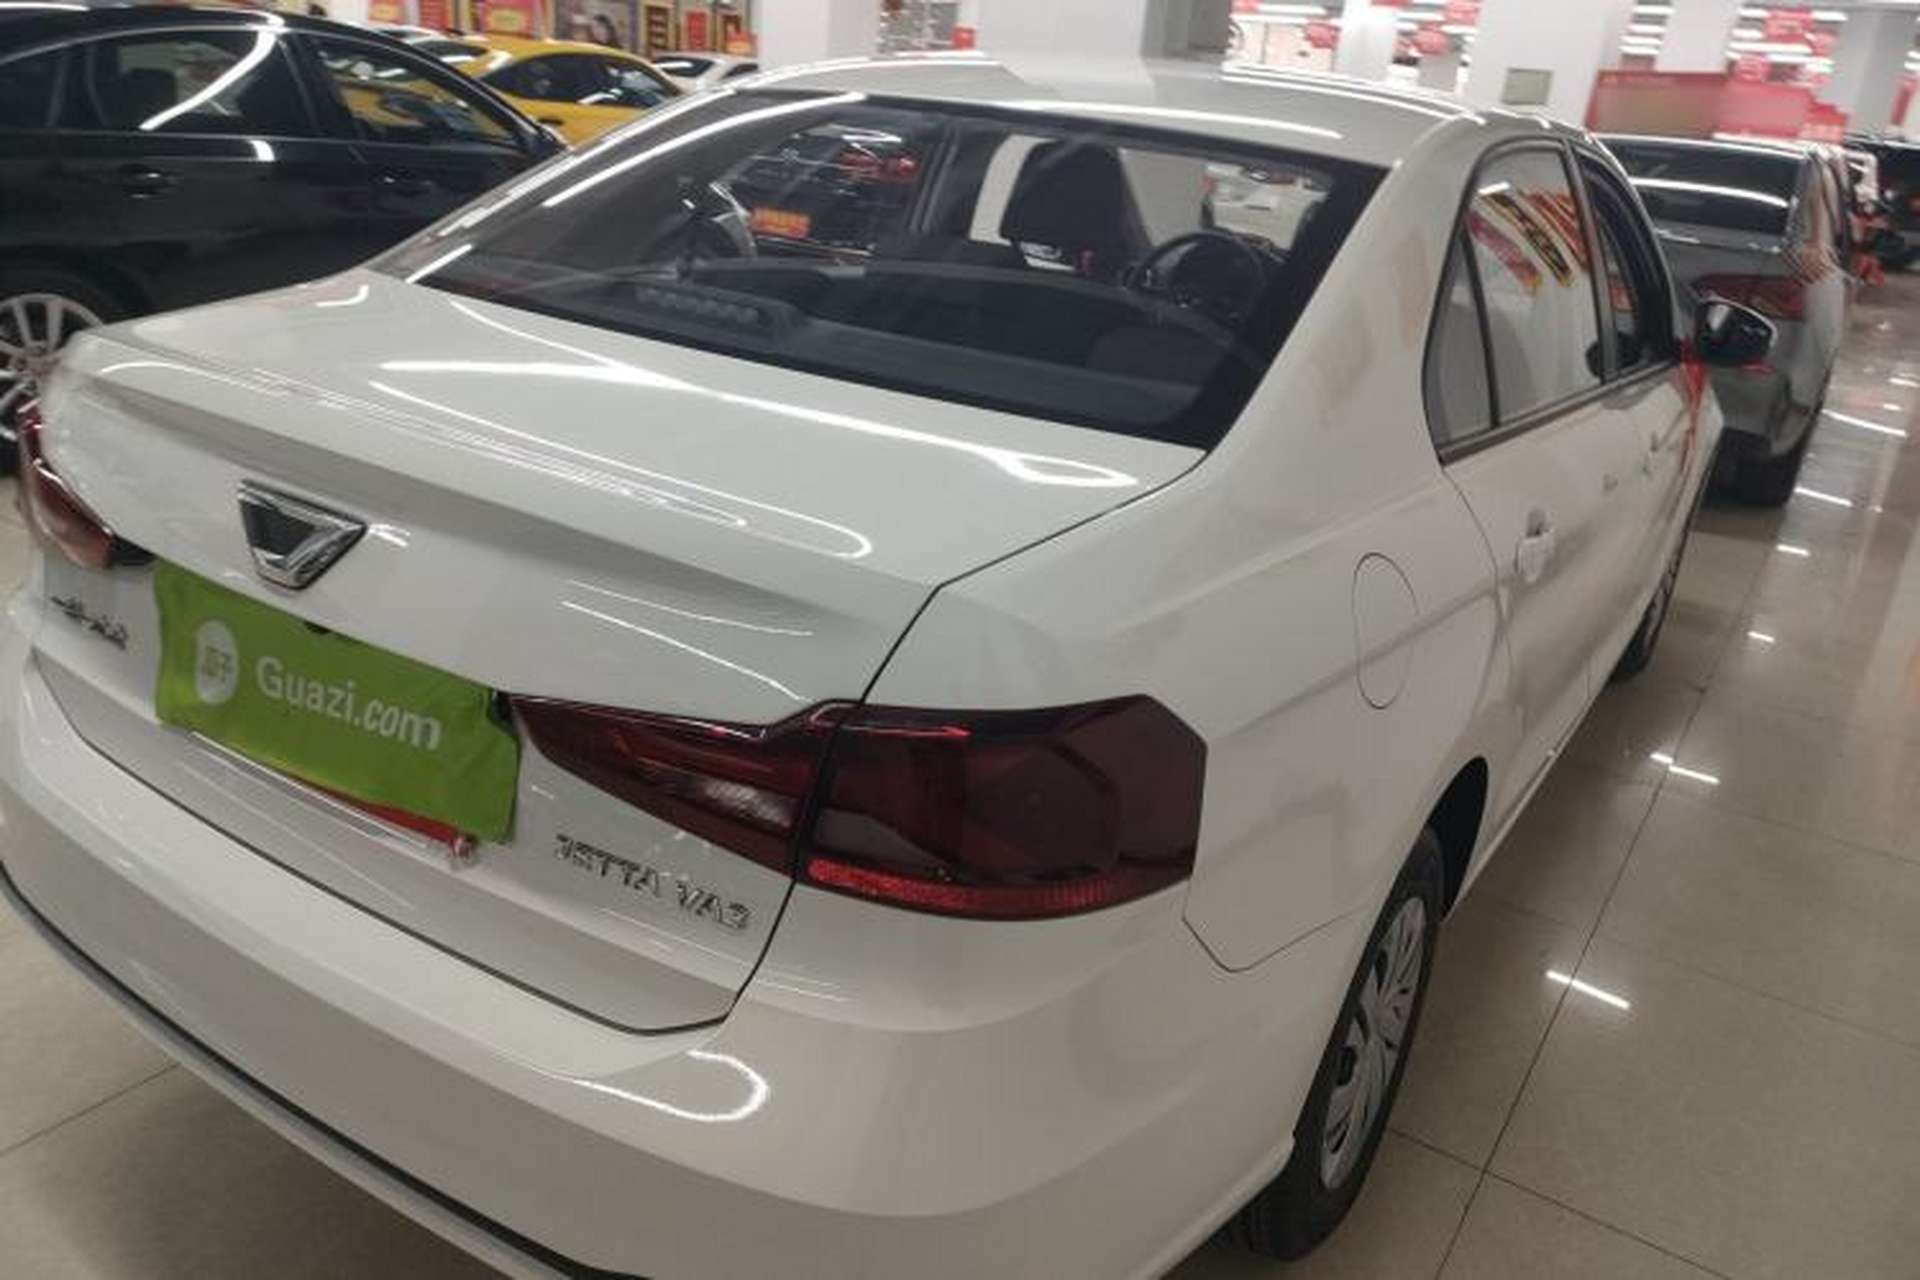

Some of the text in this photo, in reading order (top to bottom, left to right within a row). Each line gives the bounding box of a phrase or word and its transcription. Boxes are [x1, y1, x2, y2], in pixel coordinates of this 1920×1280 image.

[256, 655, 442, 751] Guazi.com
[555, 834, 752, 929] JETTA VA3
